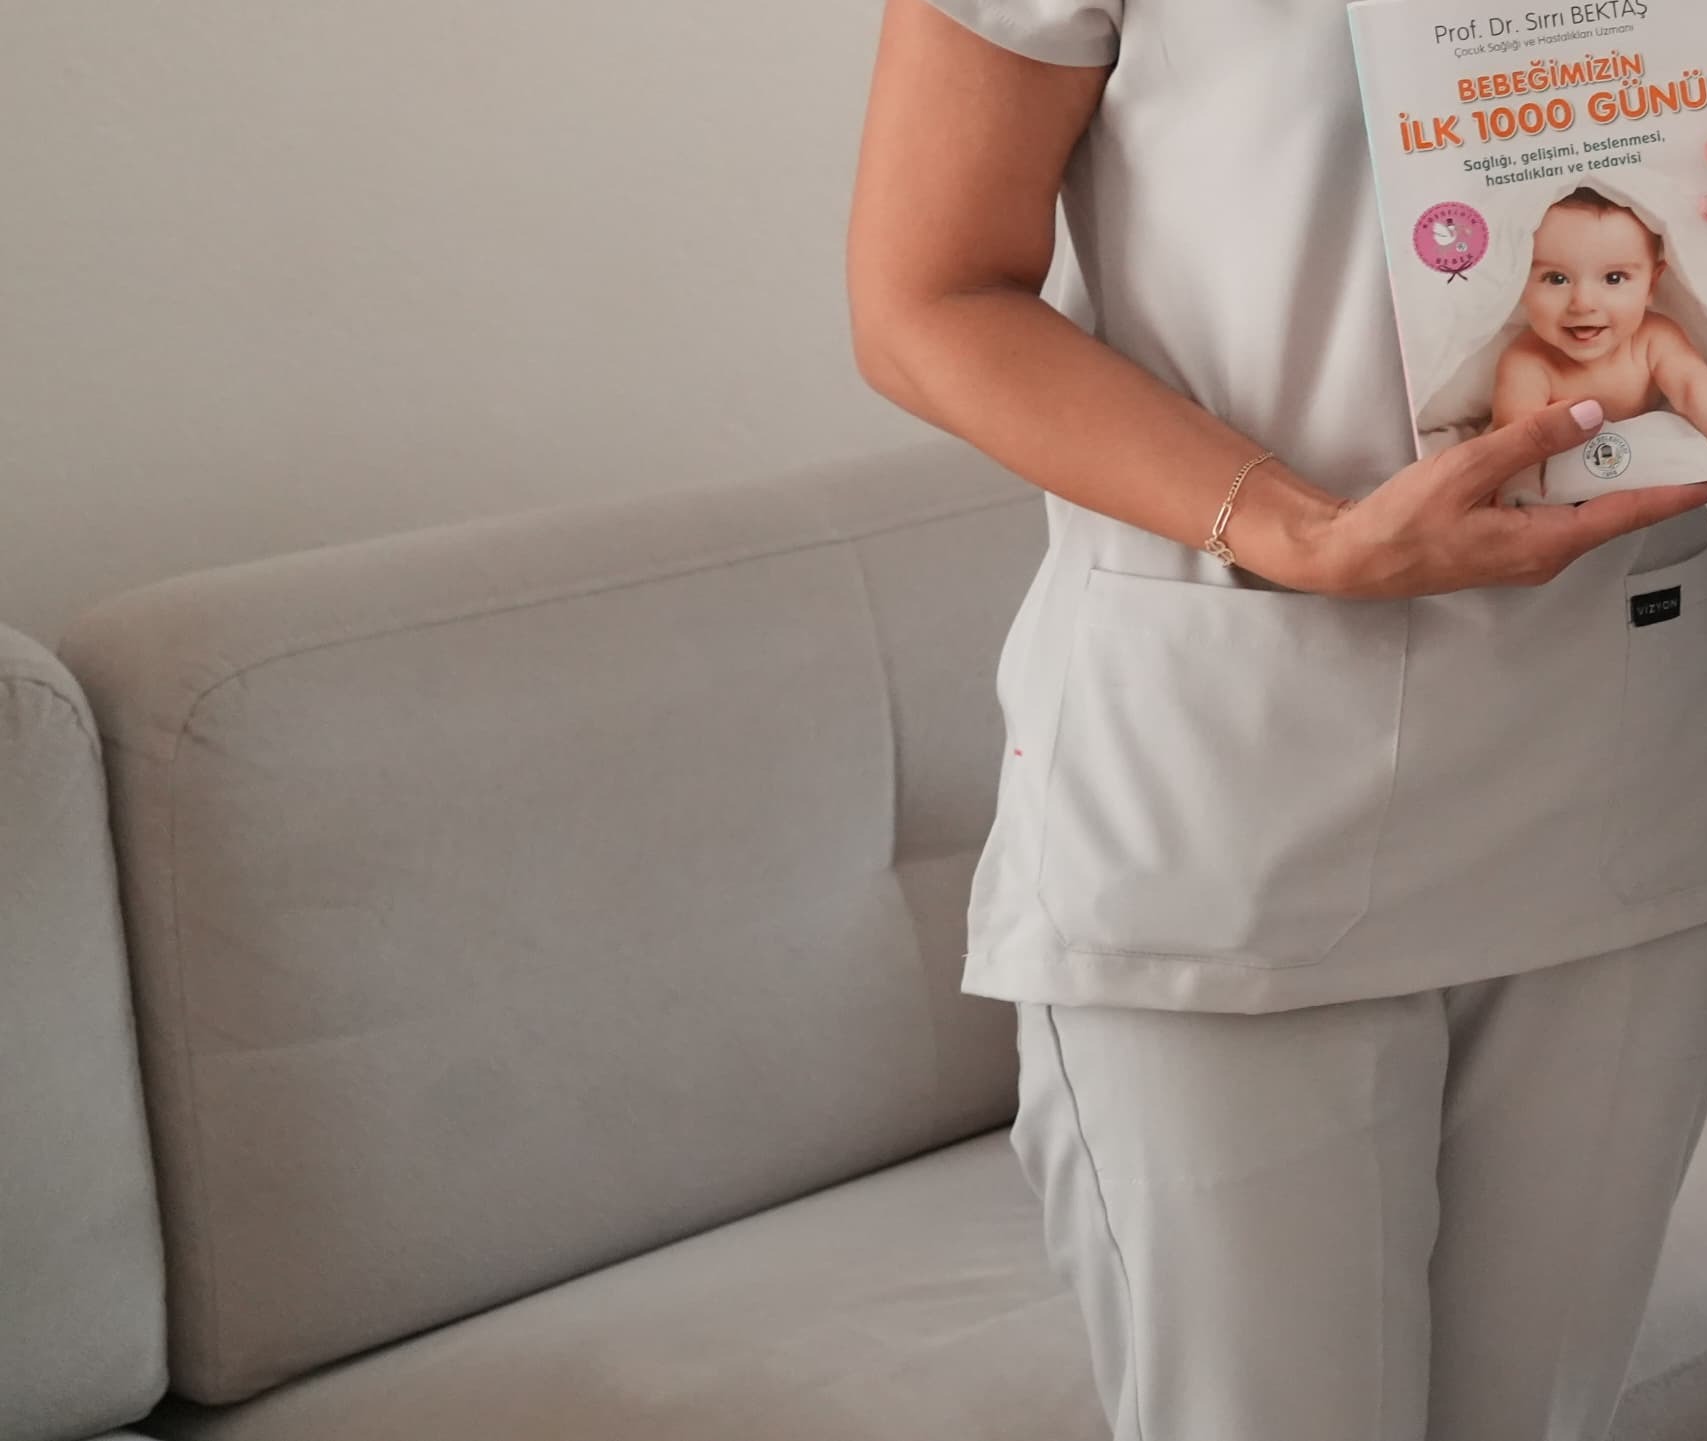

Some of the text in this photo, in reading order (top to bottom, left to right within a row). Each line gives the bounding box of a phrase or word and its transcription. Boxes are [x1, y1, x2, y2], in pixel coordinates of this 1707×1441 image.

[1434, 20, 1482, 44] Prof.
[1489, 17, 1519, 37] Dr.
[1525, 11, 1564, 31] Sırrı
[1454, 44, 1485, 58] Çocuk
[1488, 40, 1521, 54] Sağlığı
[1523, 38, 1536, 47] ve
[1595, 24, 1634, 37] Uzmanı
[1457, 50, 1643, 102] BEBEĞİMİZİN
[1399, 112, 1463, 152] İLK
[1472, 98, 1573, 143] 1000
[1463, 130, 1665, 173] Sağlığı, gelişimi, beslenmesi,
[1485, 151, 1642, 187] hastalıkları ve tedavisi
